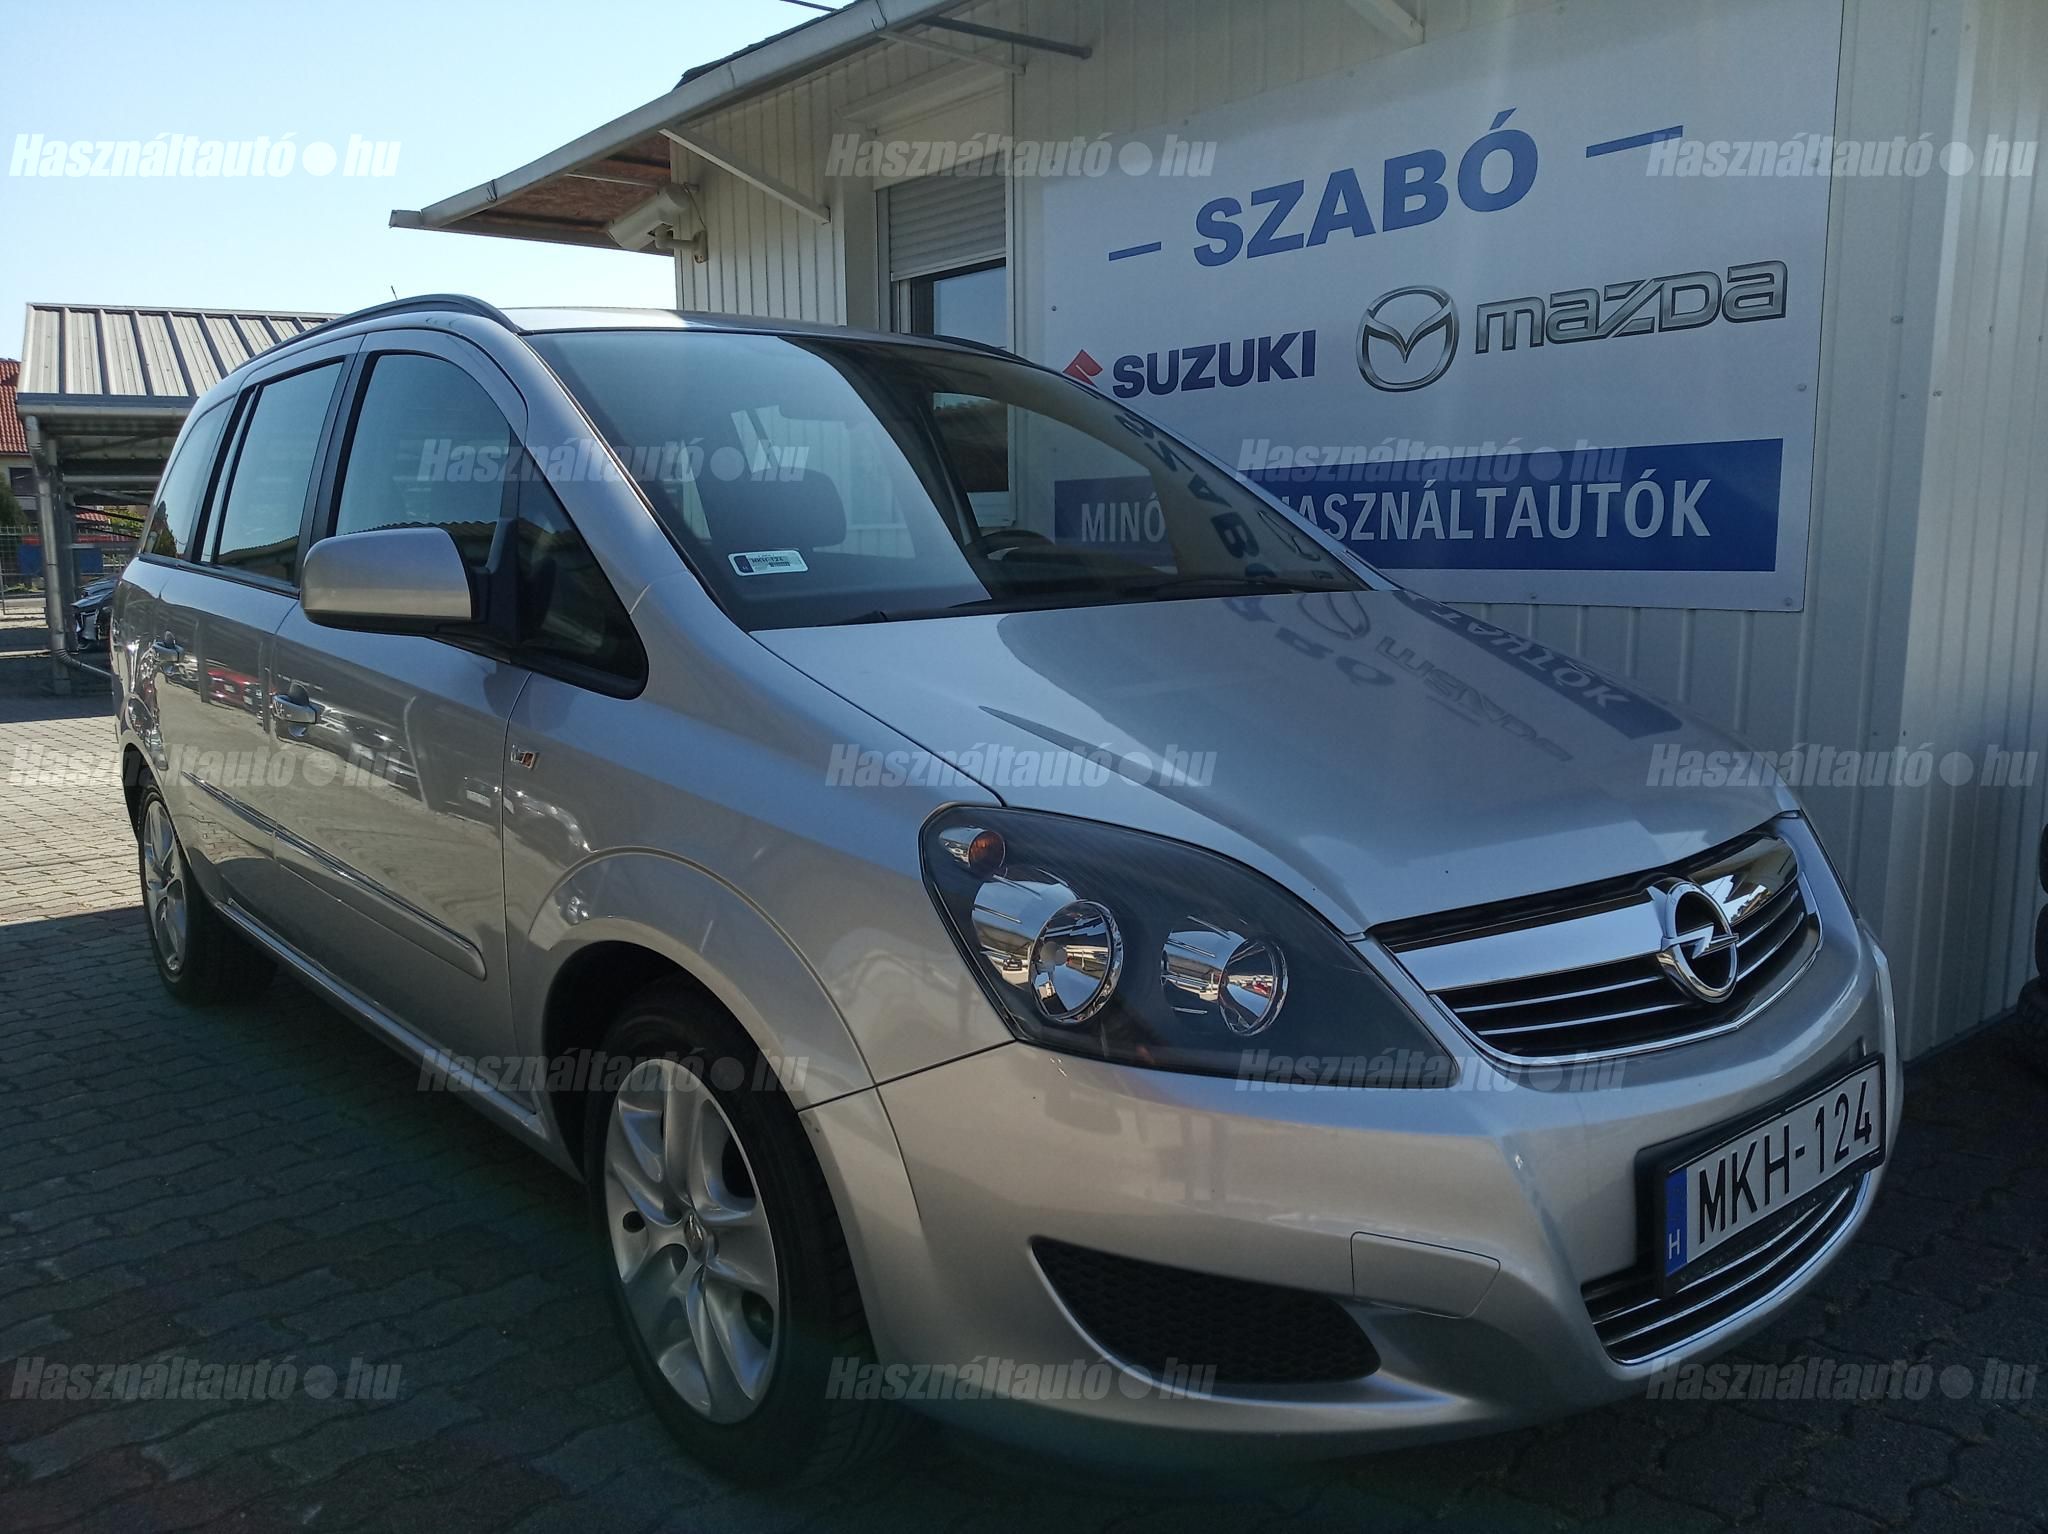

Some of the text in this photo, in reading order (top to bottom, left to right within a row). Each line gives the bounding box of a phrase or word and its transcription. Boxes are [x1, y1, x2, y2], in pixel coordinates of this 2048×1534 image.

[1194, 107, 1538, 267] SZABÓ
[1112, 330, 1316, 399] SUZUKI
[1699, 1080, 1873, 1245] MKH-124
[1668, 1229, 1680, 1260] H
